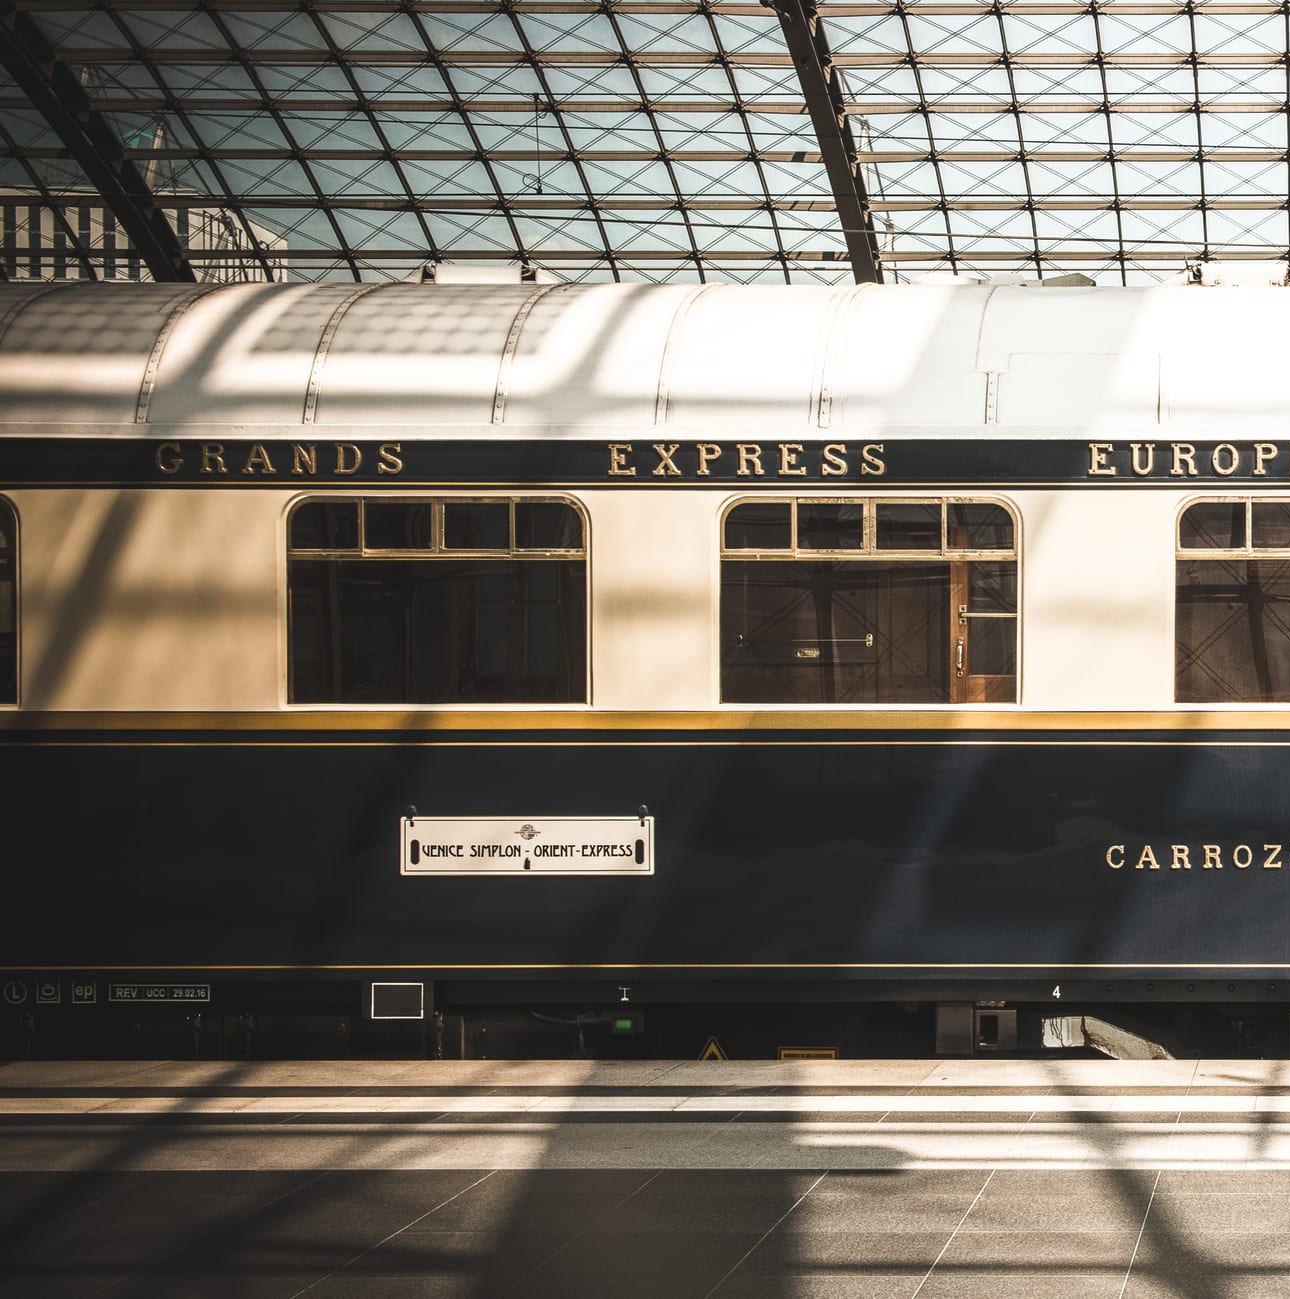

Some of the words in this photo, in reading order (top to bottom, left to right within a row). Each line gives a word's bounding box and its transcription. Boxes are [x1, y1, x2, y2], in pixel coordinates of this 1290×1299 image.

[155, 442, 403, 476] GRANDS
[608, 443, 887, 477] EXPRESS
[422, 844, 464, 858] VENICE
[470, 844, 521, 858] SIMPLON
[533, 844, 633, 858] ORIENT-EXPRESS
[75, 985, 93, 999] ep
[116, 987, 138, 998] REV
[146, 987, 166, 998] UCC
[172, 987, 206, 998] 29.02.16
[1052, 985, 1062, 999] 4
